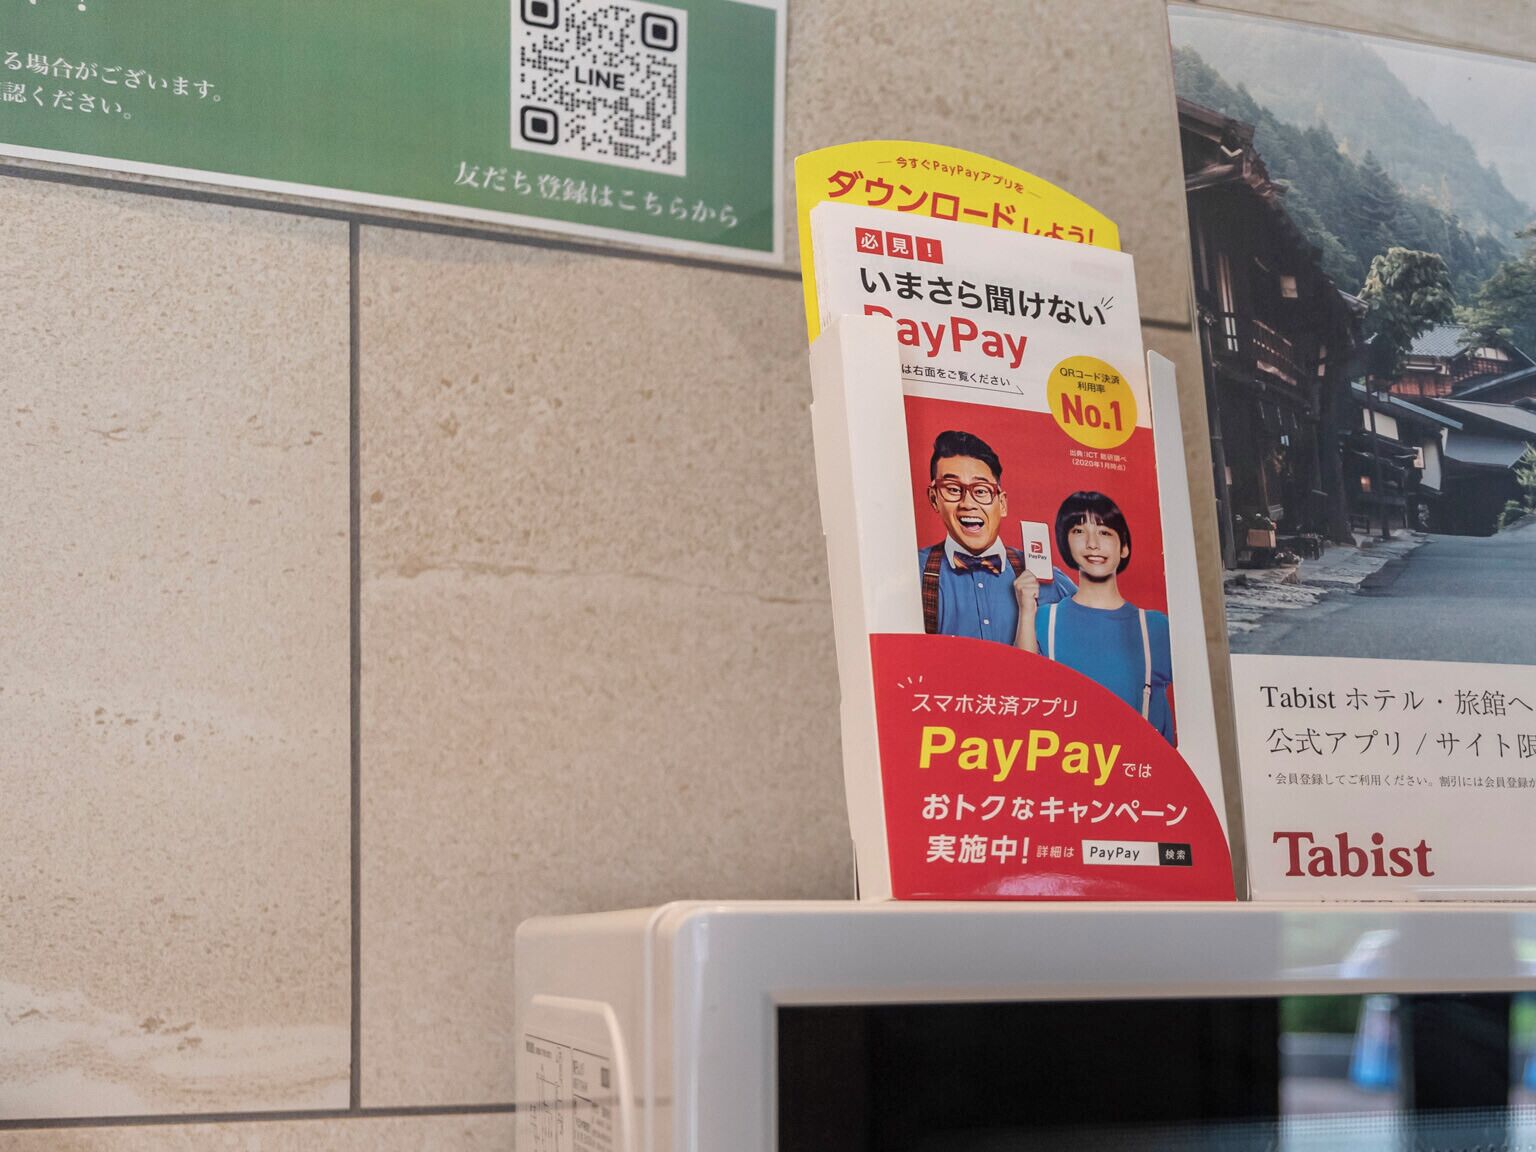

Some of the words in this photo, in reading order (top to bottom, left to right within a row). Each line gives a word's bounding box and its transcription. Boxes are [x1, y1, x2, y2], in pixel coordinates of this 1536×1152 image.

[4, 51, 221, 102] る場合がございます。
[575, 66, 625, 92] LINE
[0, 81, 131, 119] 認ください。
[896, 157, 1024, 193] 今すぐPayPayアプリを
[454, 161, 739, 228] 友だち登録はこちらから
[859, 230, 936, 260] 必見!
[860, 267, 1107, 327] いまさら聞けない
[1059, 367, 1120, 384] QRコード決済
[1077, 381, 1106, 394] 利用率
[1061, 393, 1122, 431] No.1
[911, 693, 1079, 718] スマホ決済アプリ
[1260, 686, 1336, 709] Tabist
[1266, 727, 1400, 756] 公式アプリ
[921, 793, 1188, 826] おトクなキャンペーン
[926, 834, 1030, 864] 実施中!
[1036, 845, 1075, 859] 詳細は
[1089, 846, 1141, 863] PayPay
[1164, 848, 1187, 861] 検索
[1272, 831, 1435, 878] Tabist
